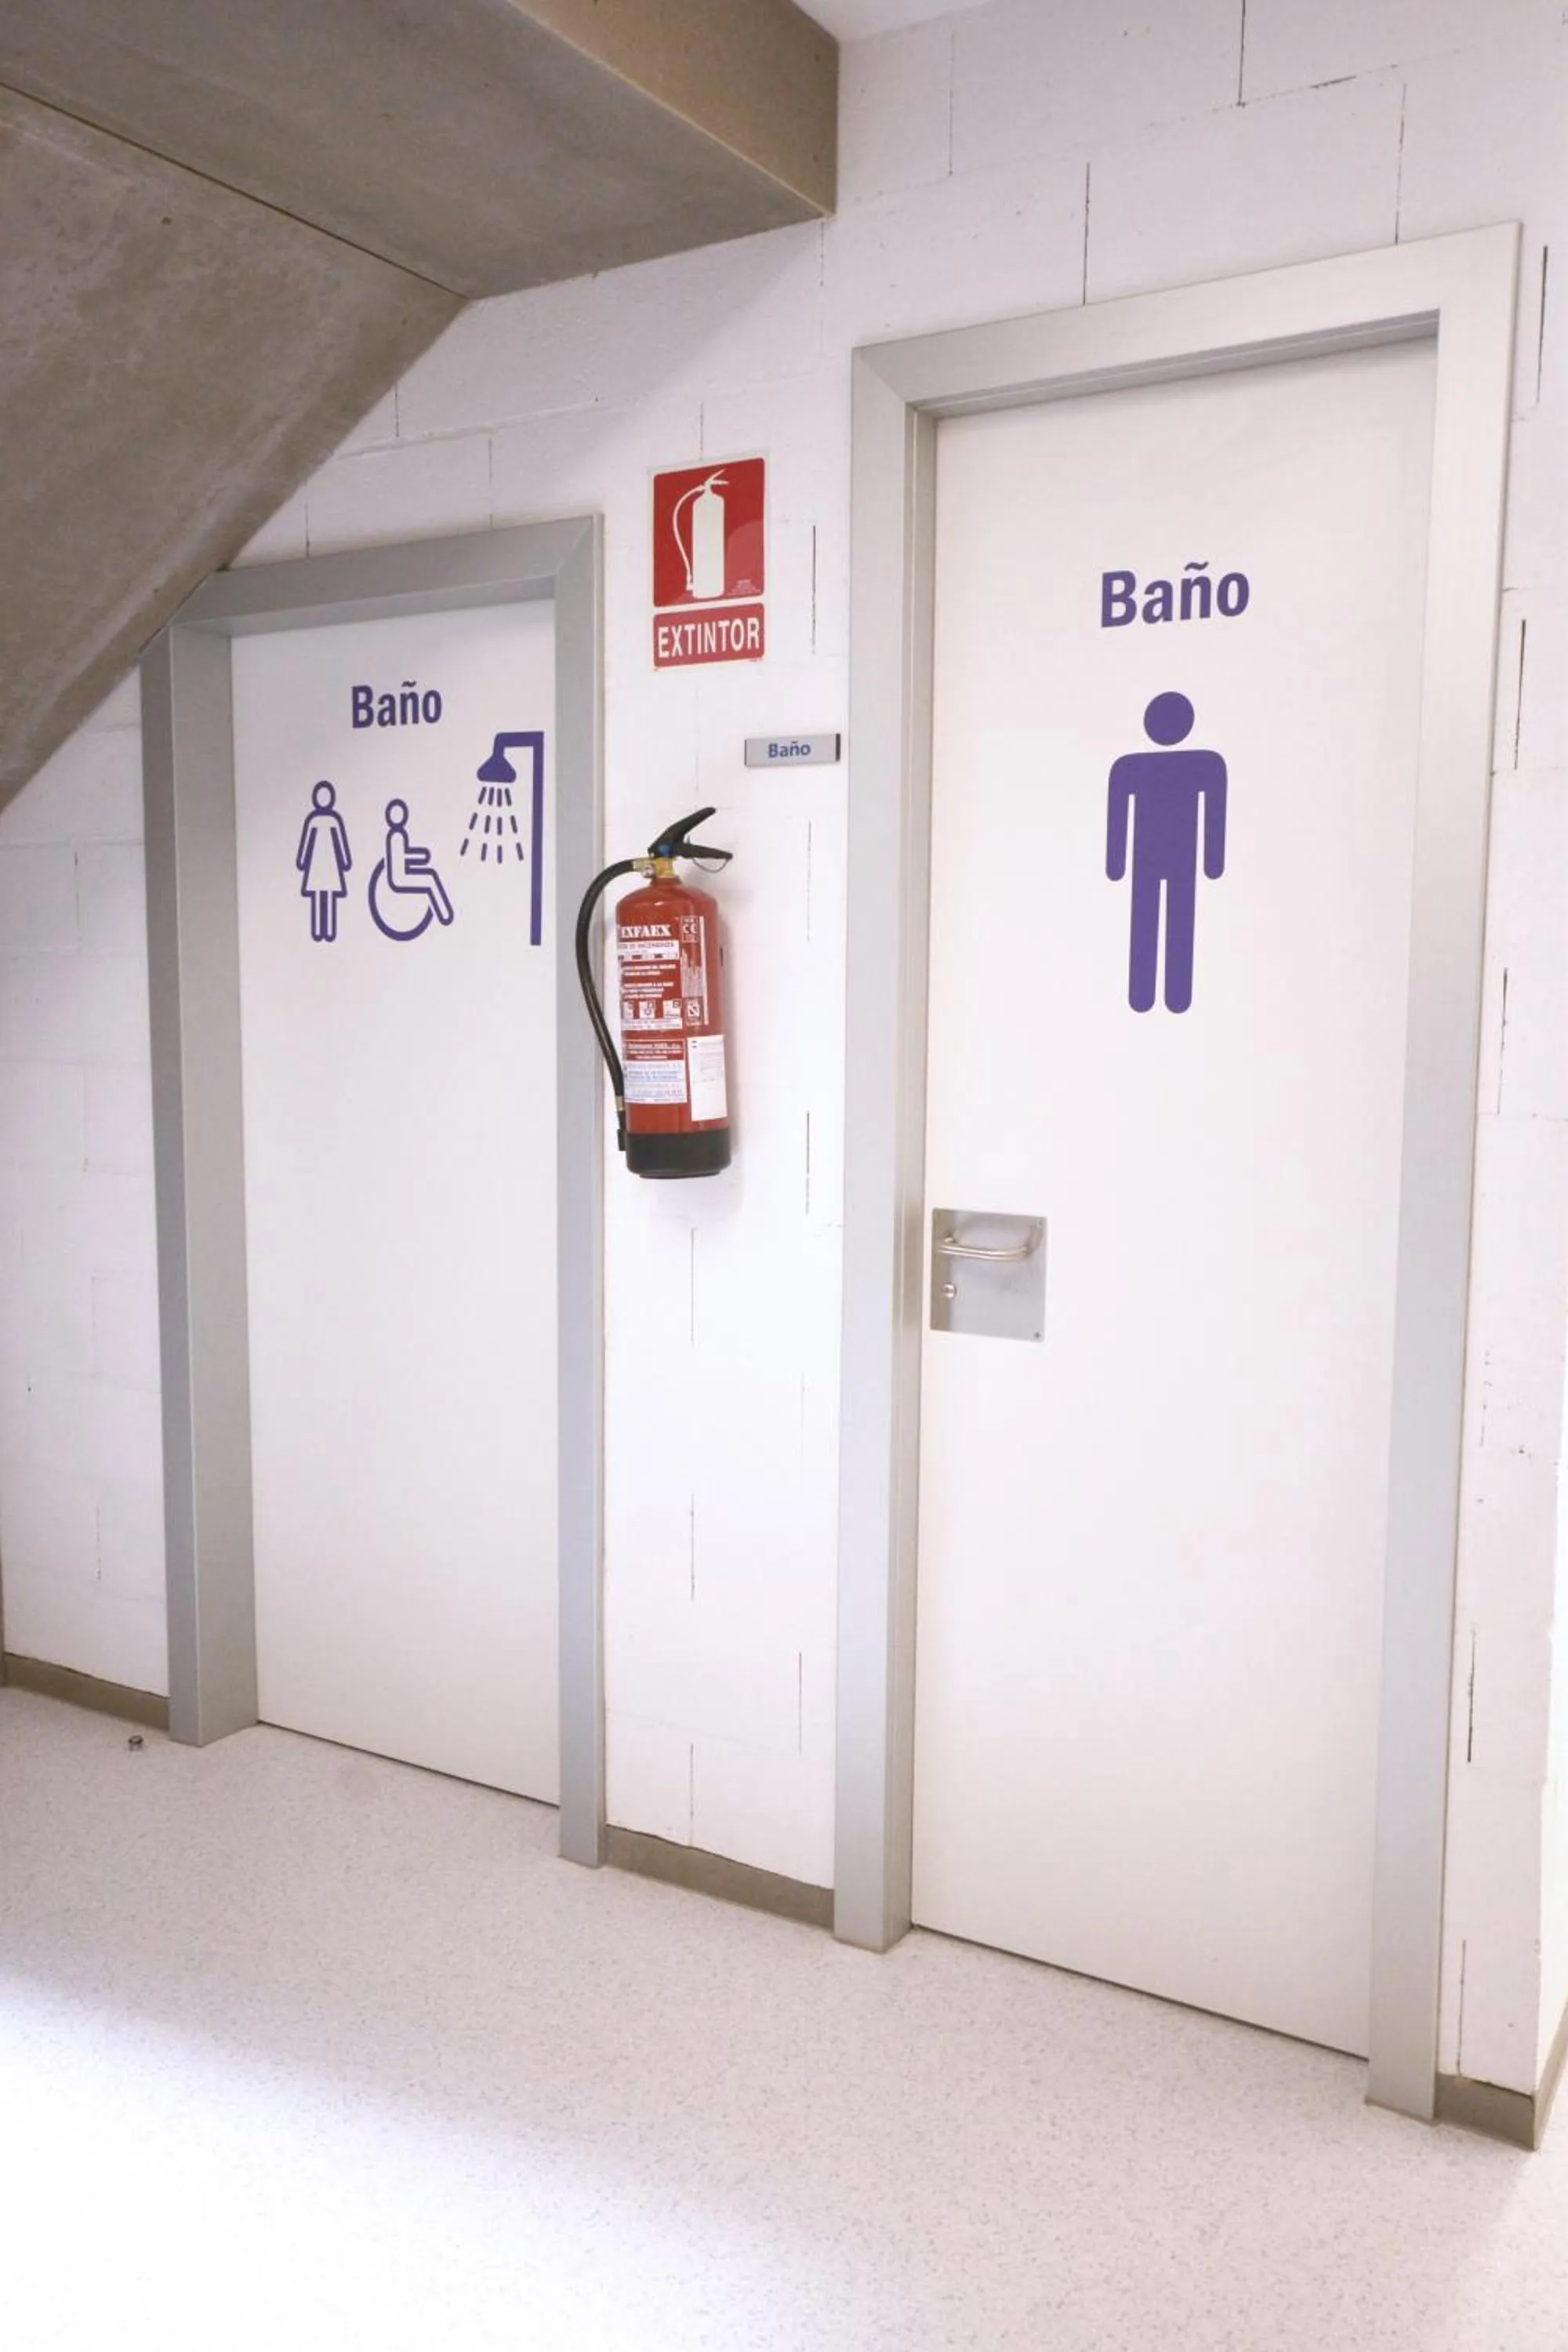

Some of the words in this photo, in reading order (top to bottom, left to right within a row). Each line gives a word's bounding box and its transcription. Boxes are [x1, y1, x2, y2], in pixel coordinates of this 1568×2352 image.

[1101, 561, 1250, 627] Baño
[658, 617, 760, 658] EXTINTOR
[351, 681, 442, 728] Baño
[768, 741, 811, 758] Baño
